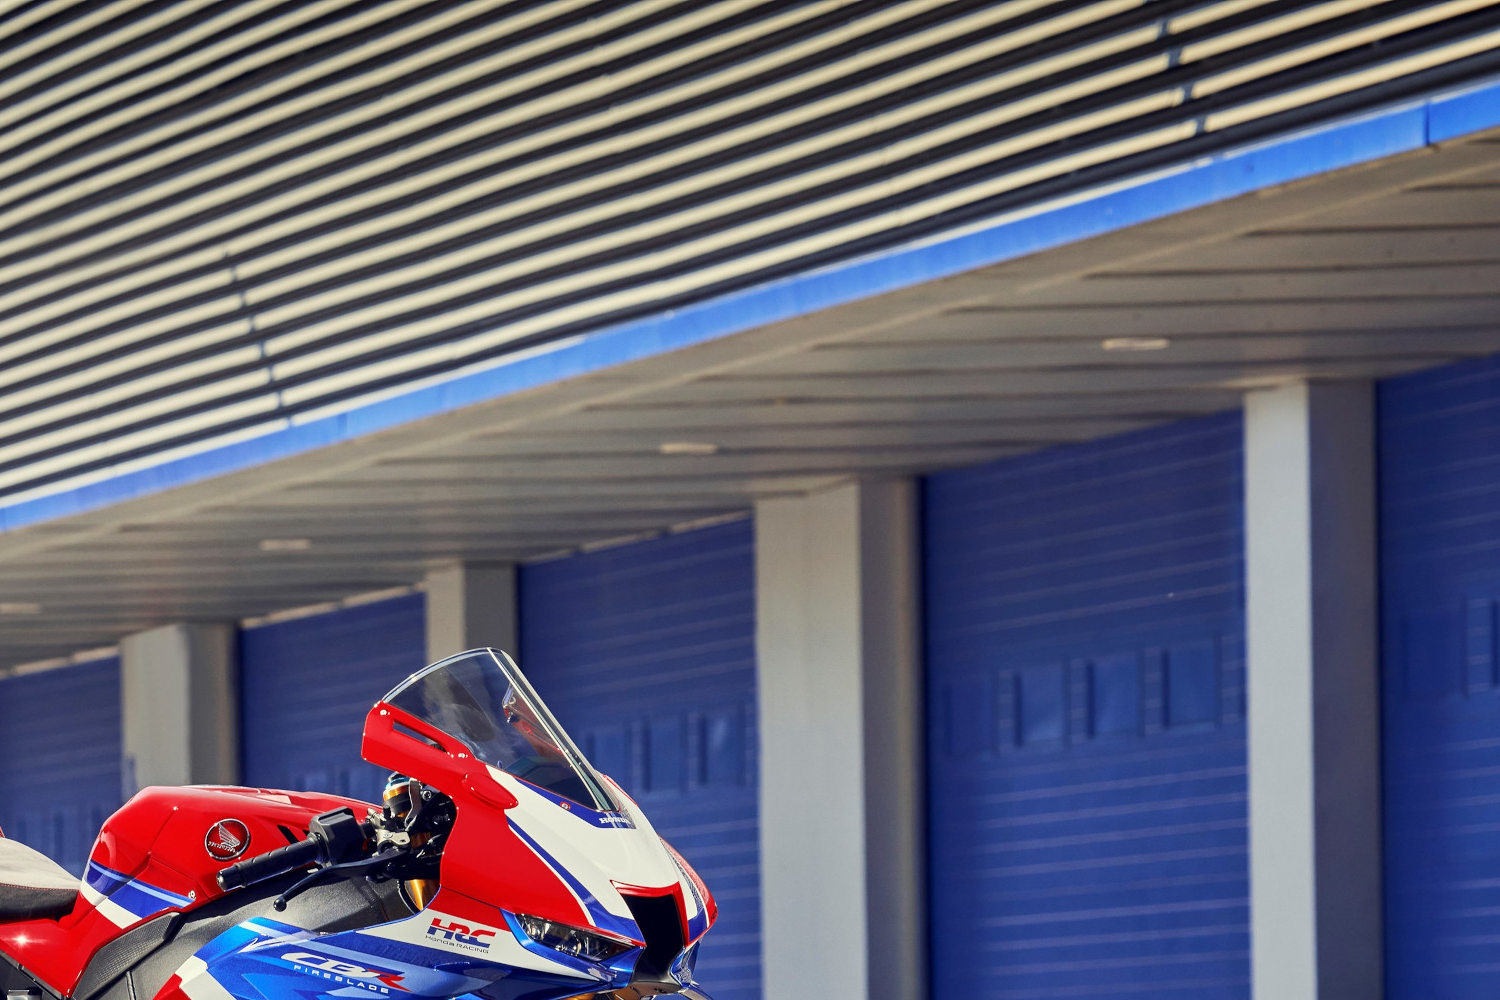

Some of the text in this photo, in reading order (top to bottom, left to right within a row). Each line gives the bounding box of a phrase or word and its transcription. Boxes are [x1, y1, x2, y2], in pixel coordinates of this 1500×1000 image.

[425, 934, 489, 954] Honda RACING
[427, 917, 496, 948] HRC
[293, 964, 389, 994] FIREBLADE
